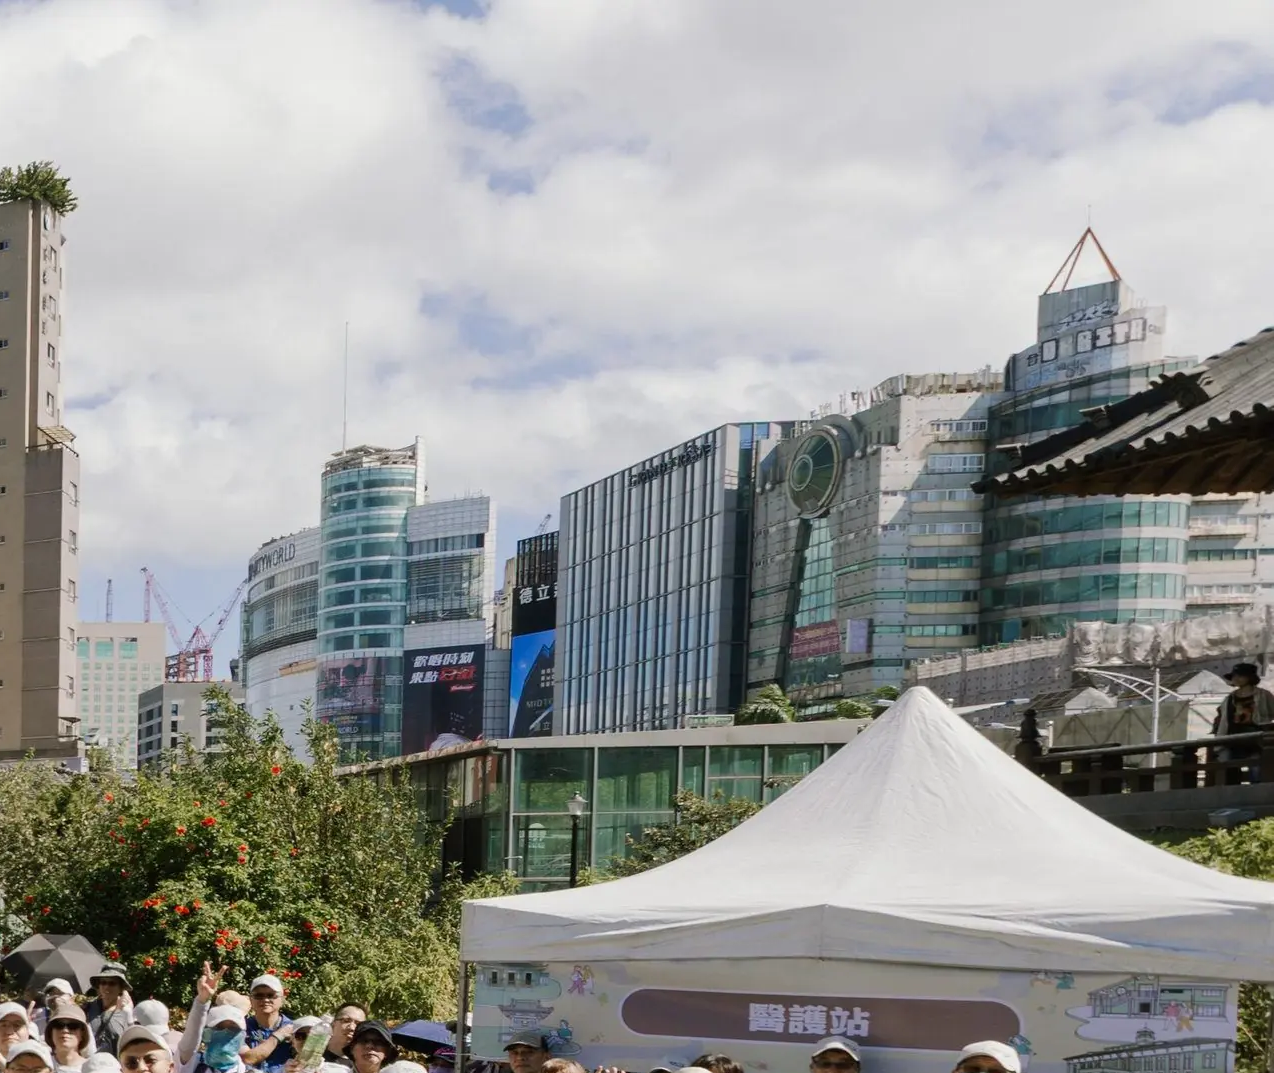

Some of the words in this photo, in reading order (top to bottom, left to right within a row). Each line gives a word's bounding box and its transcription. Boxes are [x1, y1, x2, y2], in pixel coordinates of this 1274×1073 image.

[519, 582, 557, 605] 德立
[748, 1002, 871, 1037] 醫護站
